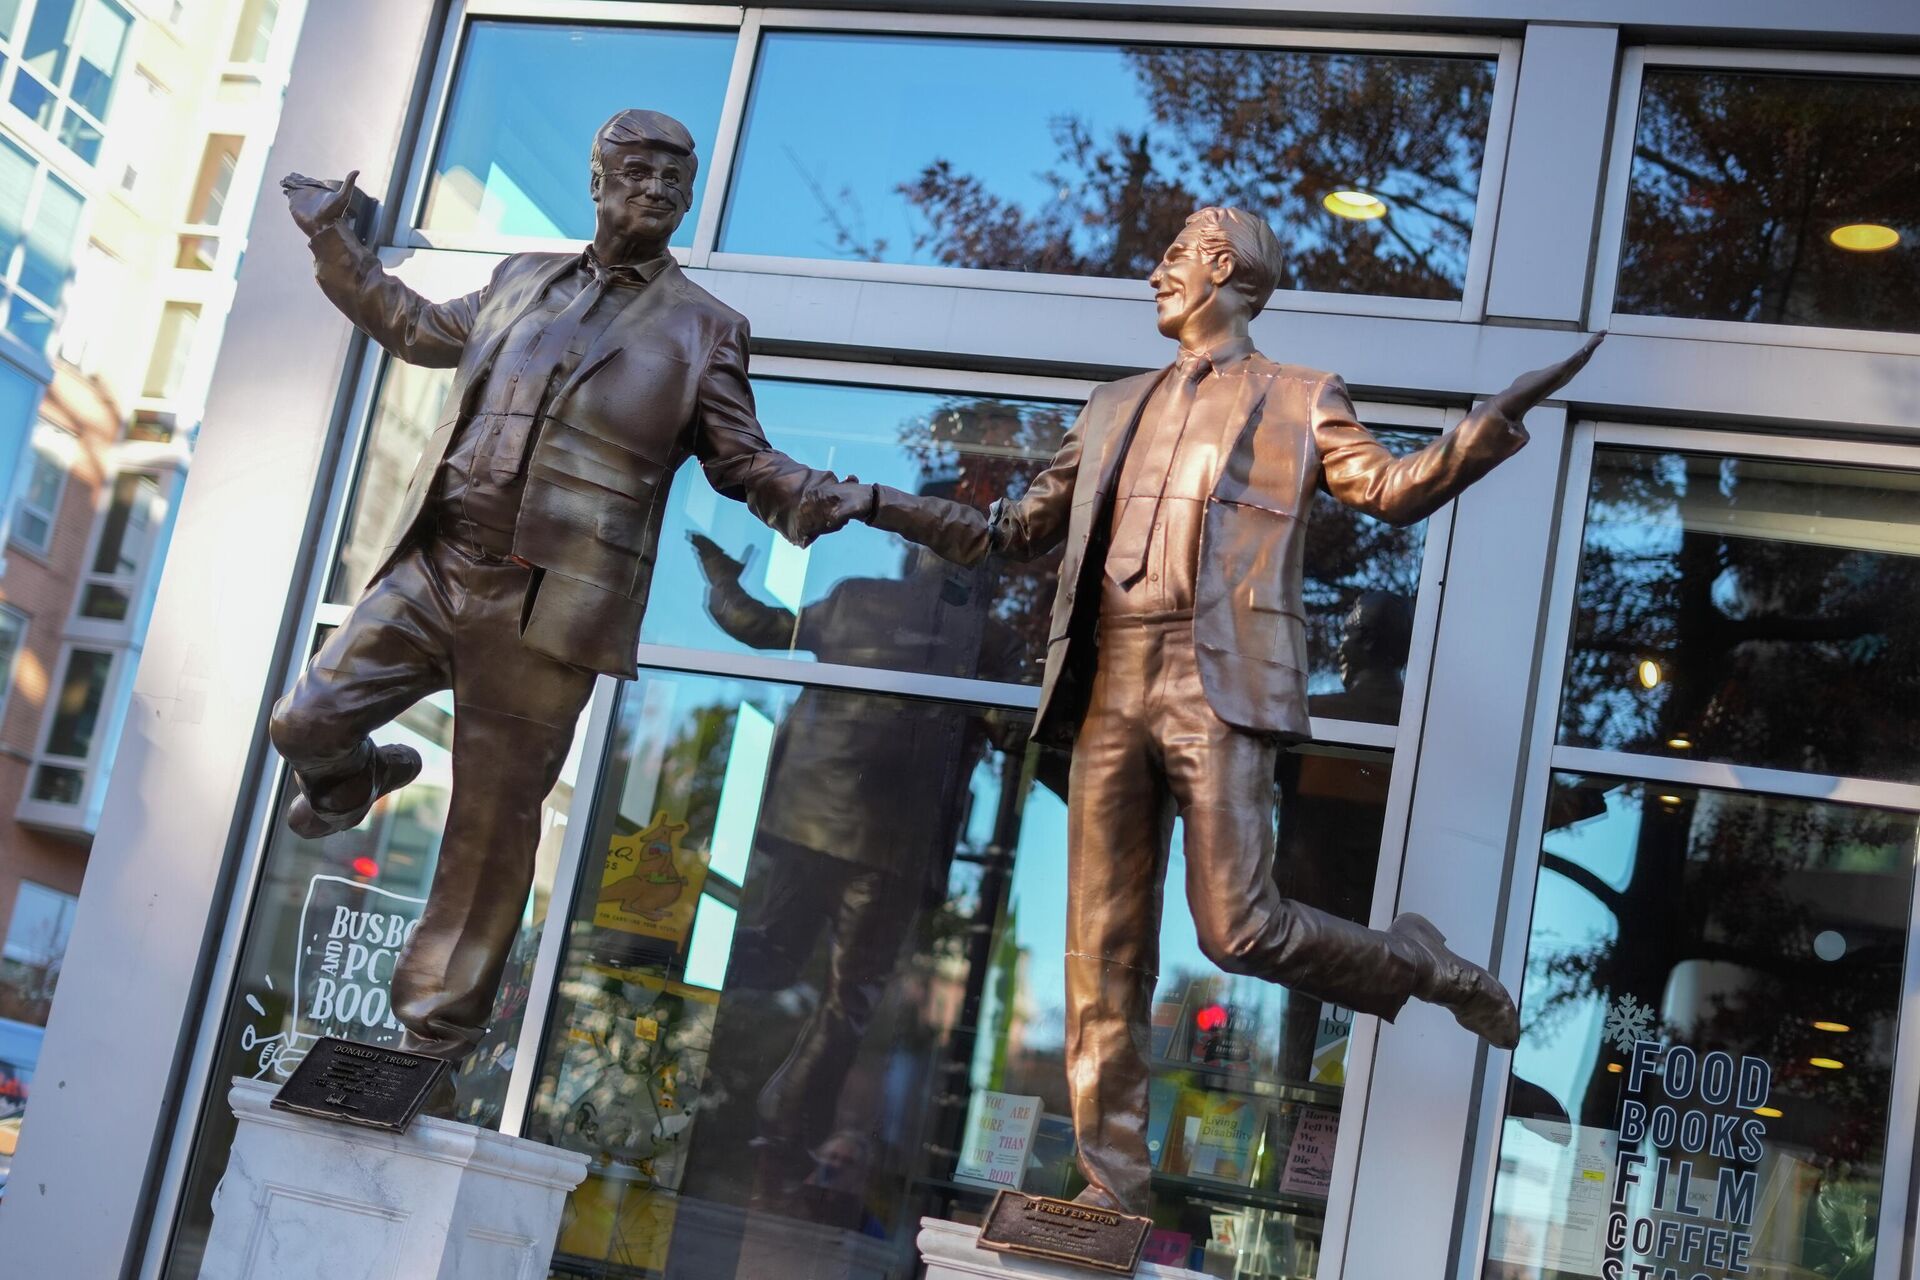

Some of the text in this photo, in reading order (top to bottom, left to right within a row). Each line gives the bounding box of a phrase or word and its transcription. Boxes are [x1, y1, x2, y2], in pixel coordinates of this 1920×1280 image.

[321, 940, 343, 977] AND
[334, 1045, 373, 1060] DONALD
[384, 1055, 418, 1068] TRUMP
[1627, 1039, 1771, 1110] FOOD
[984, 1095, 1005, 1109] YOU
[1010, 1105, 1030, 1120] ARE
[977, 1116, 1004, 1132] ORE
[1206, 1115, 1238, 1130] Living
[1203, 1126, 1252, 1141] Disability
[1619, 1099, 1766, 1163] BOOKS
[999, 1136, 1025, 1150] THAN
[1297, 1143, 1319, 1154] Will
[973, 1148, 994, 1163] OUR
[1293, 1154, 1311, 1165] Die
[989, 1168, 1017, 1184] BODY
[1612, 1150, 1758, 1226] FILM
[1071, 1208, 1118, 1226] EPSTEIN
[1606, 1211, 1752, 1274] COFFEE
